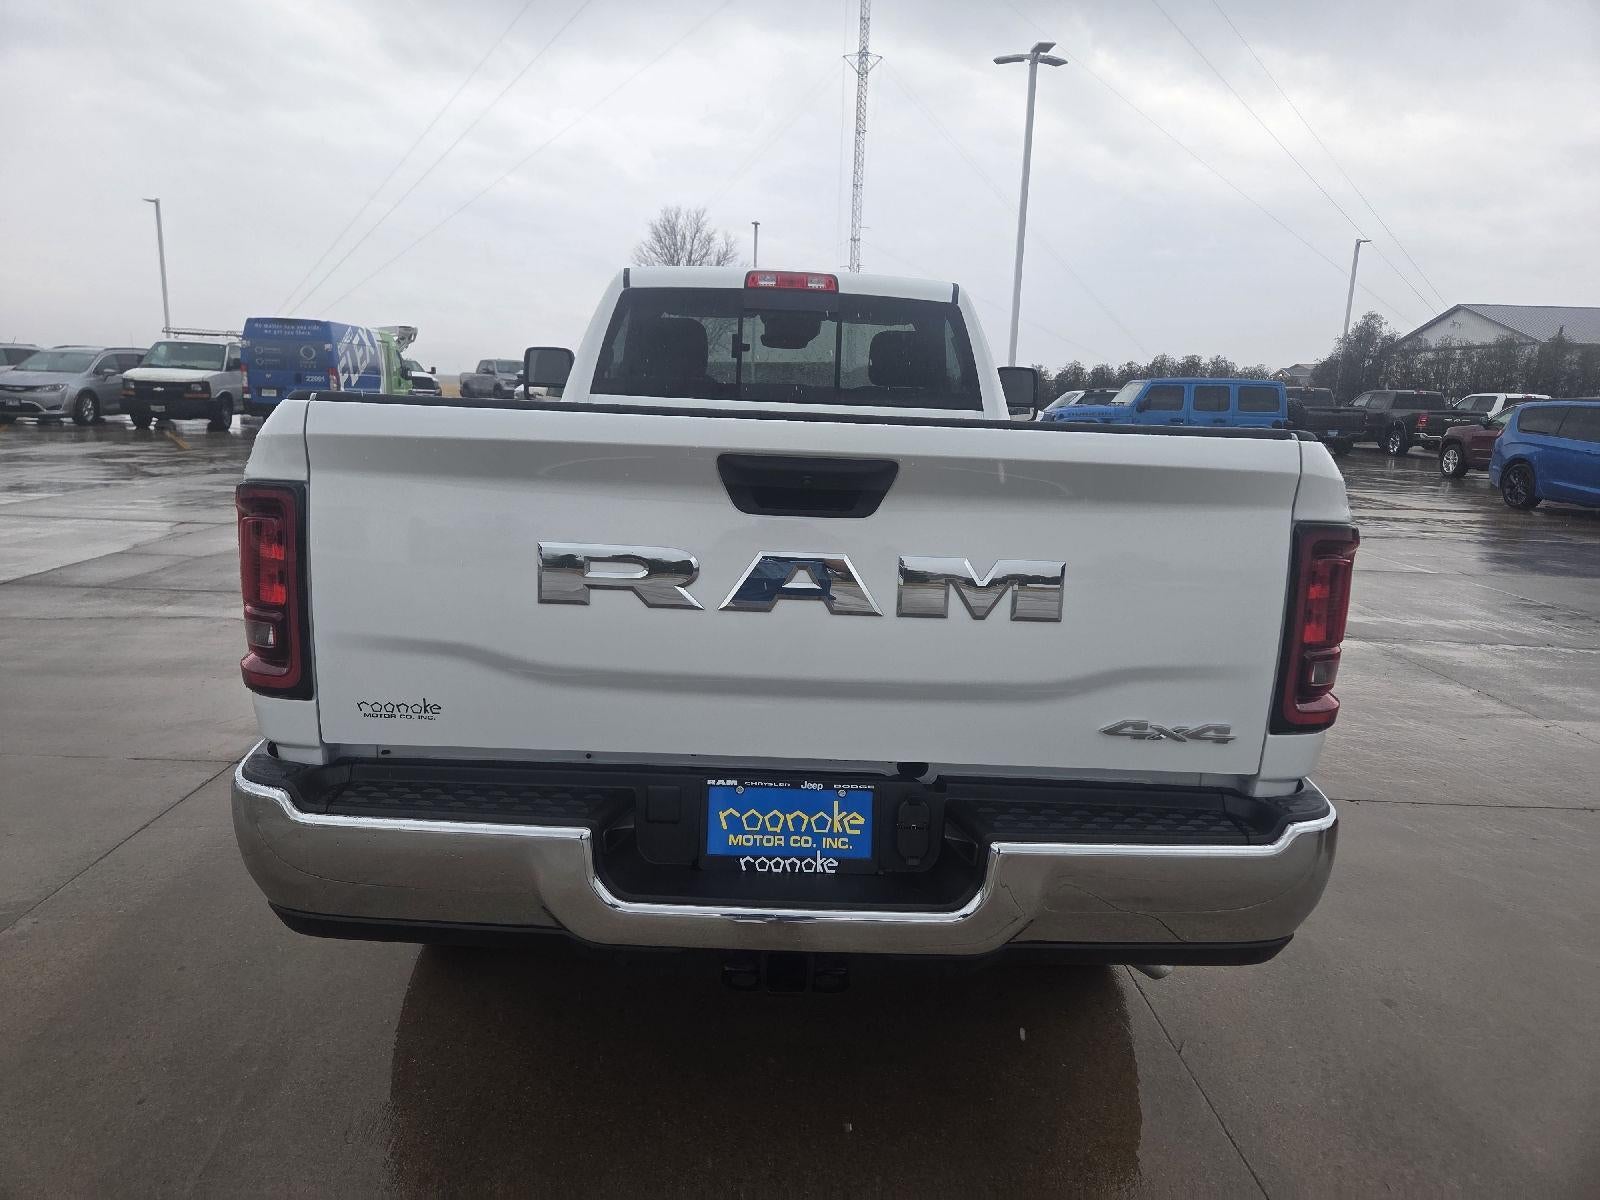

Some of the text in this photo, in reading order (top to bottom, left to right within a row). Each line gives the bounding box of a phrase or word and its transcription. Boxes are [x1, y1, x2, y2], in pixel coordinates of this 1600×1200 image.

[537, 541, 1066, 622] RAM
[800, 780, 824, 791] Jeep
[719, 800, 865, 835] roanoke
[728, 834, 853, 850] MOTOR CO. INC.
